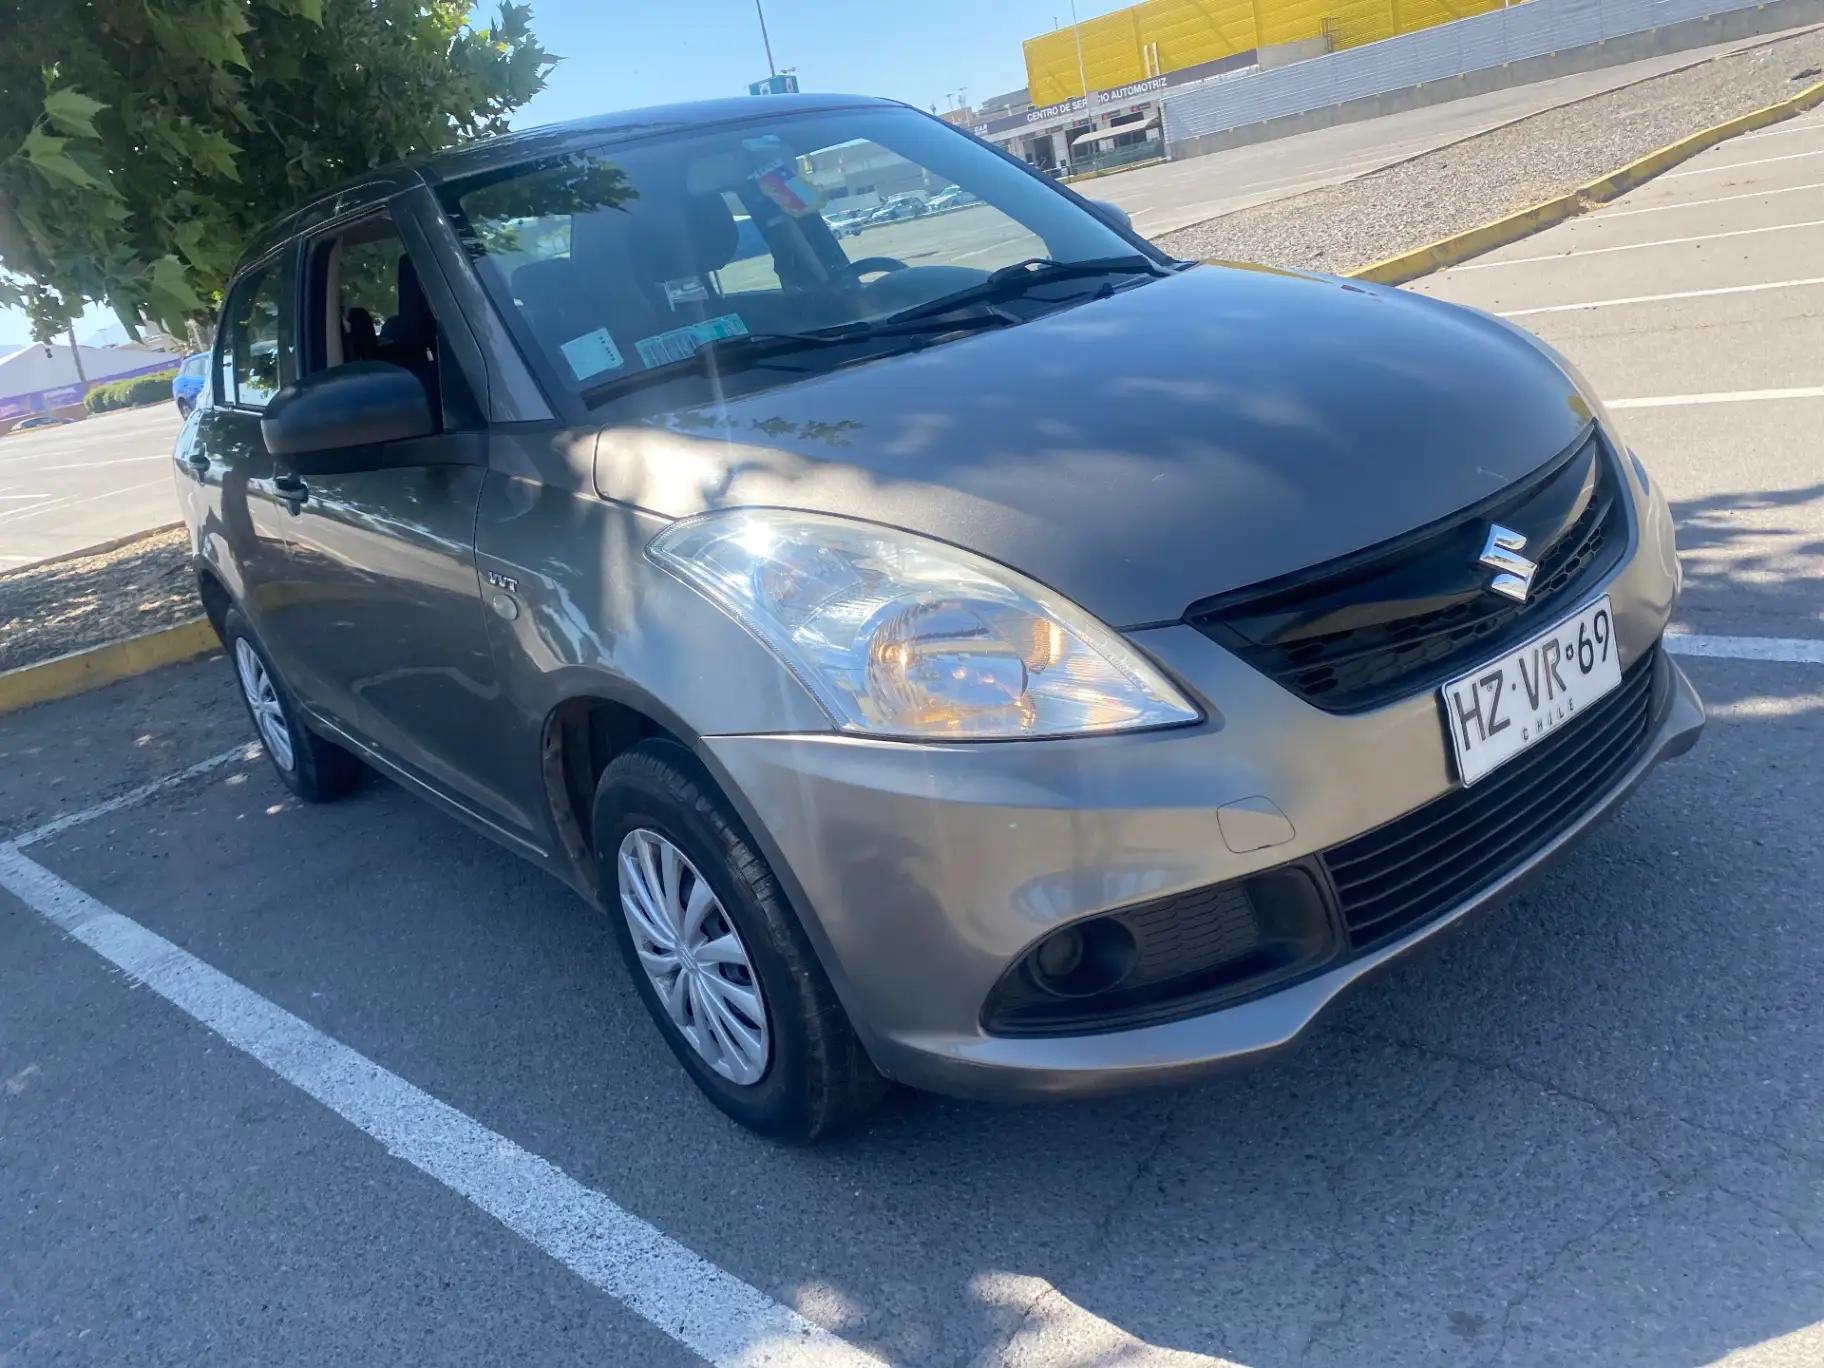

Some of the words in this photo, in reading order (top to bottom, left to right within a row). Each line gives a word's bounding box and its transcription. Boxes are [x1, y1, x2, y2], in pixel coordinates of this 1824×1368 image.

[1027, 106, 1058, 122] CENTRO
[1059, 103, 1071, 114] DE
[1071, 92, 1110, 110] SERIO
[1111, 77, 1167, 98] AUTOMOTRIZ
[1522, 699, 1575, 740] CHILE
